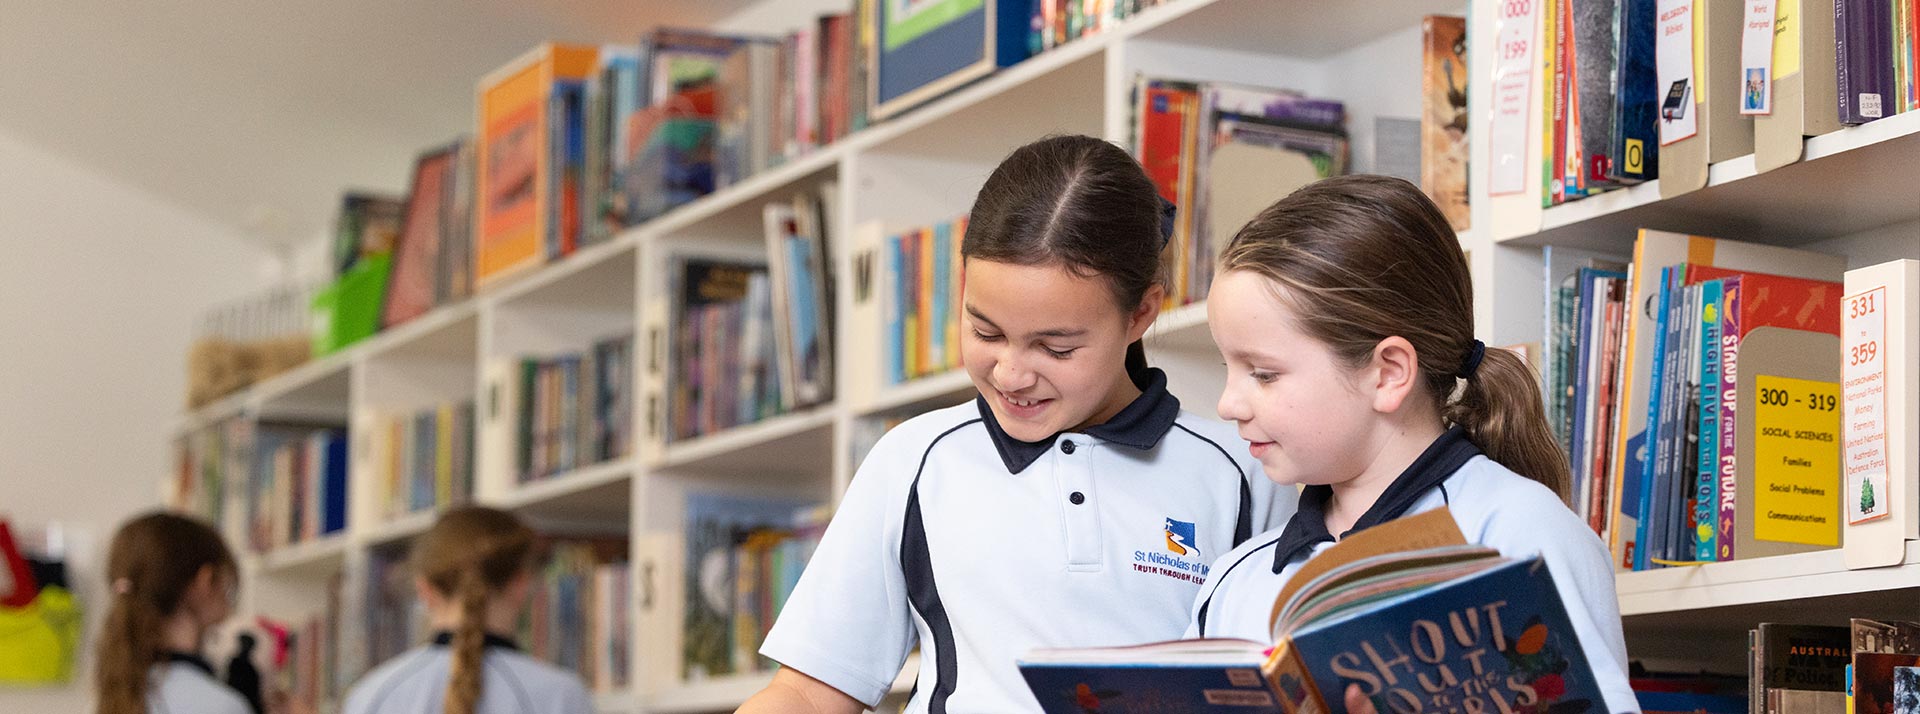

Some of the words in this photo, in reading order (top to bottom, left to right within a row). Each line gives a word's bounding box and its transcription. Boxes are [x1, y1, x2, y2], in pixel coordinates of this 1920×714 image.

[1850, 293, 1876, 319] 331
[1706, 327, 1719, 374] HIGH
[1723, 335, 1738, 384] STAND
[1850, 341, 1877, 367] 359
[1703, 382, 1717, 426] FIVE
[1722, 389, 1736, 412] UP
[1760, 388, 1789, 407] 300
[1808, 393, 1836, 412] 319
[1762, 427, 1791, 438] SOCIAL
[1795, 430, 1833, 442] SCIENCES
[1783, 456, 1812, 468] Families
[1853, 449, 1878, 461] Australian
[1870, 459, 1885, 470] Force
[1721, 455, 1736, 512] FUTURE
[1769, 483, 1791, 493] Social
[1793, 485, 1825, 496] Problems
[1699, 471, 1712, 520] BOYS
[1767, 510, 1826, 524] Communications
[1133, 563, 1158, 574] TRUTH
[1159, 568, 1191, 581] THROUGH
[1134, 550, 1146, 562] St
[1148, 552, 1190, 571] Nicholas
[1191, 563, 1201, 573] of
[1330, 601, 1507, 696] SHOUT
[1791, 646, 1851, 657] AUSTRAL
[1386, 648, 1486, 714] OUT
